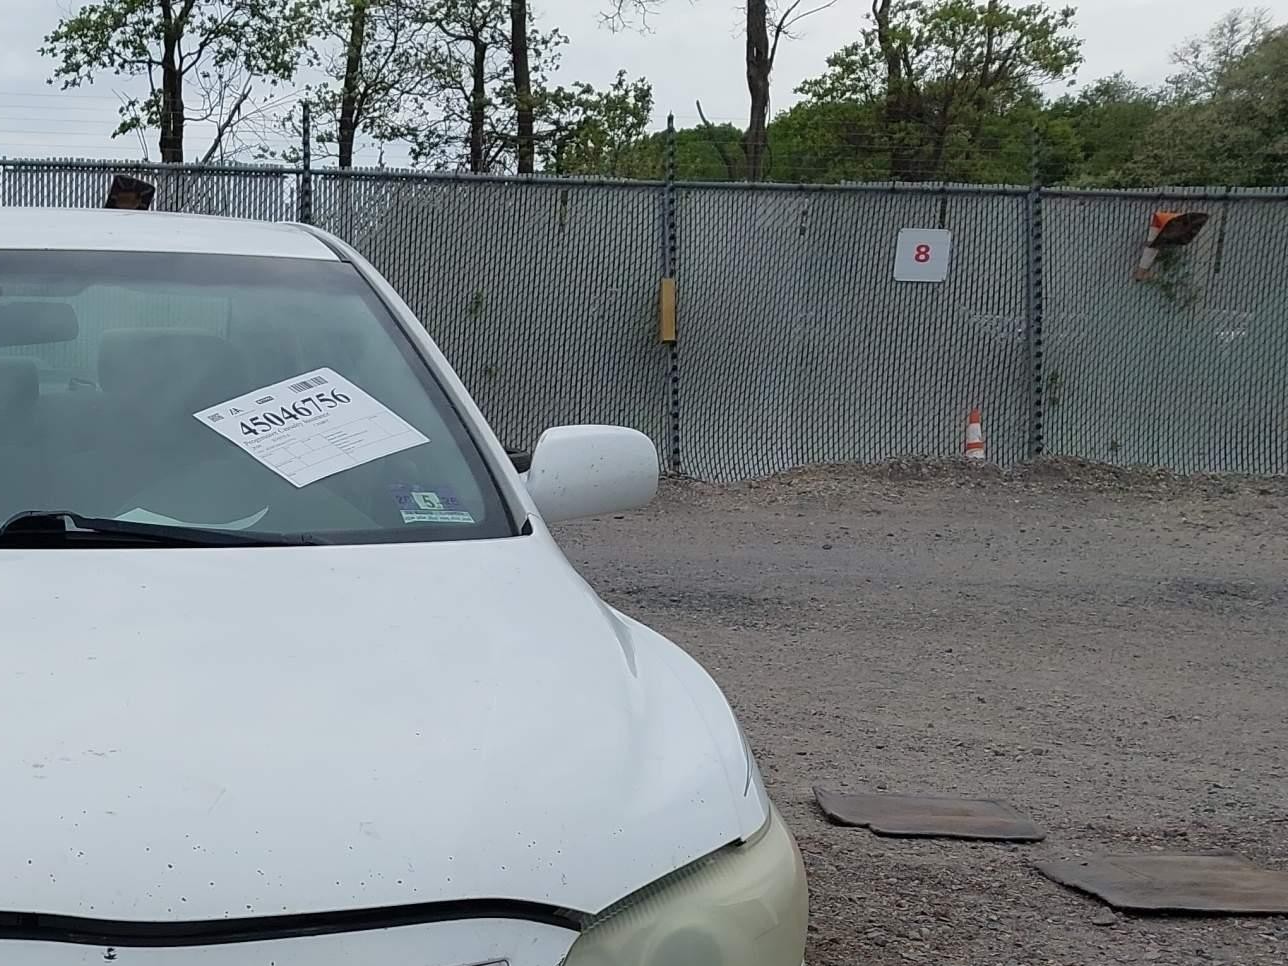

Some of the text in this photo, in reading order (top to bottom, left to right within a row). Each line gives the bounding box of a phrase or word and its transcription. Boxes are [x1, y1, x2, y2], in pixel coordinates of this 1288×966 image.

[915, 245, 930, 262] 8
[239, 387, 352, 436] 45046756
[421, 494, 436, 508] 5
